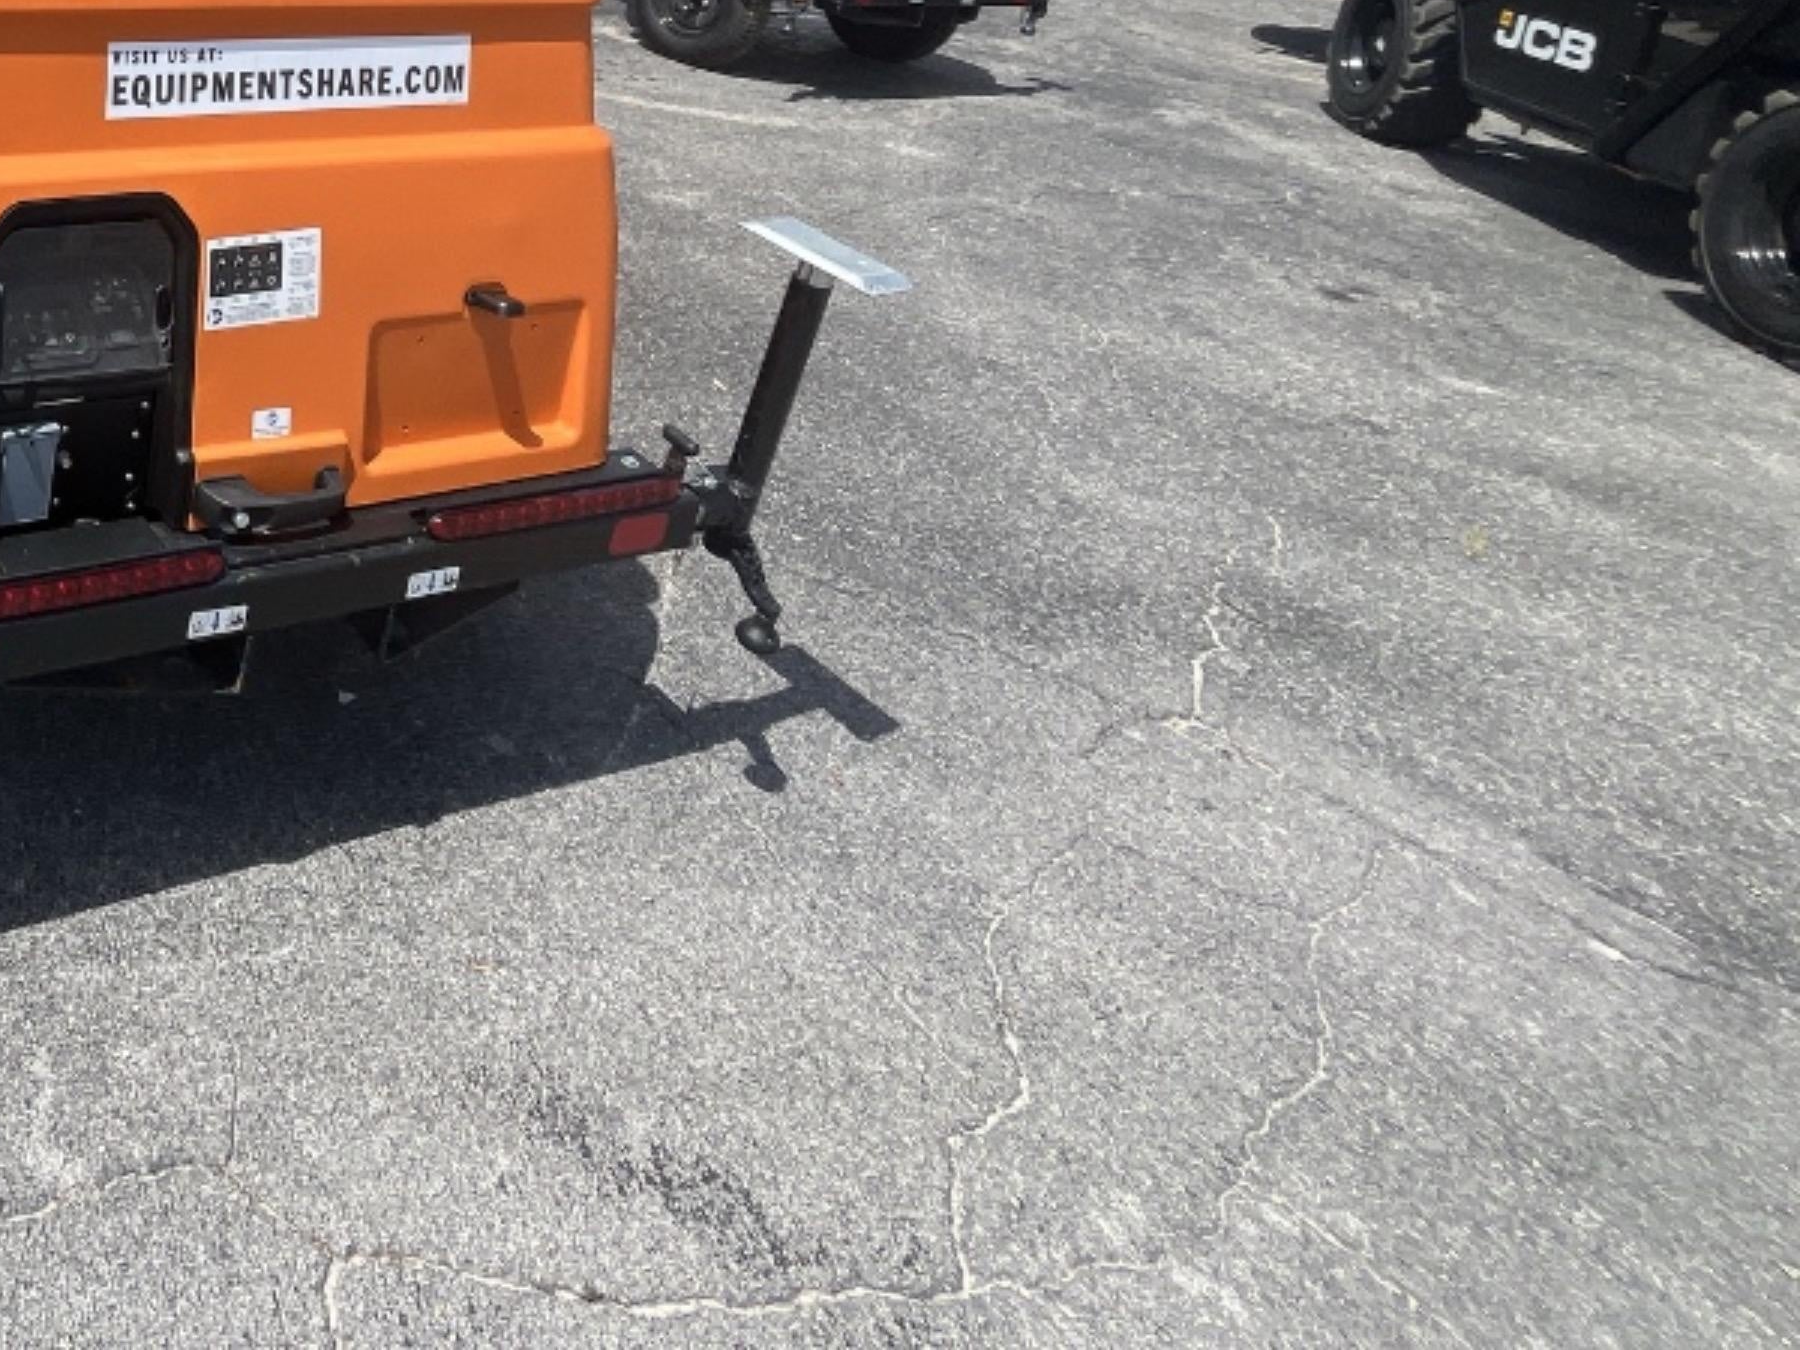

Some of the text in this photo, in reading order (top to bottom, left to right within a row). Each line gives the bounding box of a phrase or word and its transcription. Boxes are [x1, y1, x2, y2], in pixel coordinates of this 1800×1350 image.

[112, 47, 224, 66] VISIT US AT:
[1494, 11, 1597, 71] JCB
[111, 64, 466, 109] EQUIPMENTSHARE.COM
